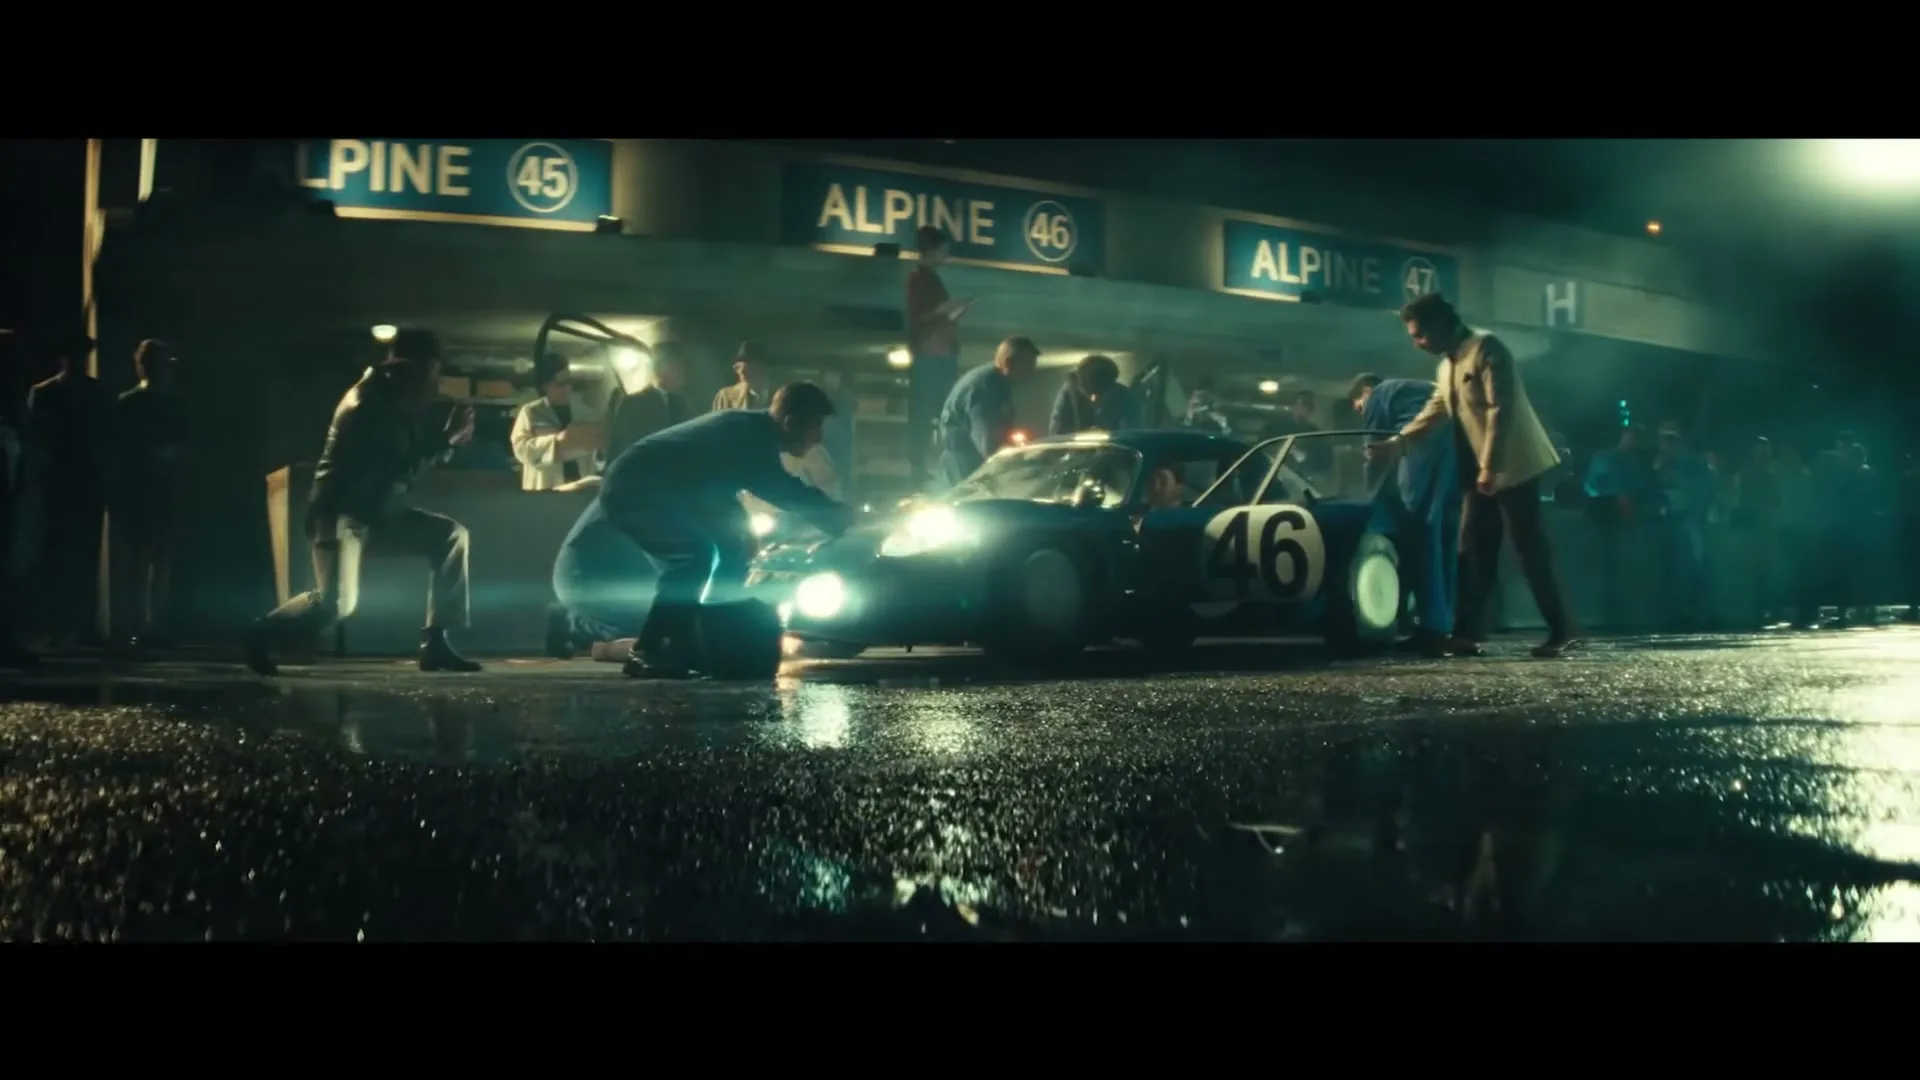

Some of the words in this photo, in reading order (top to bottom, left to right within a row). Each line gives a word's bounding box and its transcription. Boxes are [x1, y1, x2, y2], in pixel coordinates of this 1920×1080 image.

[296, 138, 471, 197] LPINE
[516, 156, 571, 198] 45
[817, 183, 994, 246] ALPINE
[1030, 212, 1070, 250] 46
[1251, 239, 1381, 294] ALPINE
[1404, 266, 1436, 296] 47
[1546, 281, 1578, 327] H
[1207, 510, 1309, 599] 46
